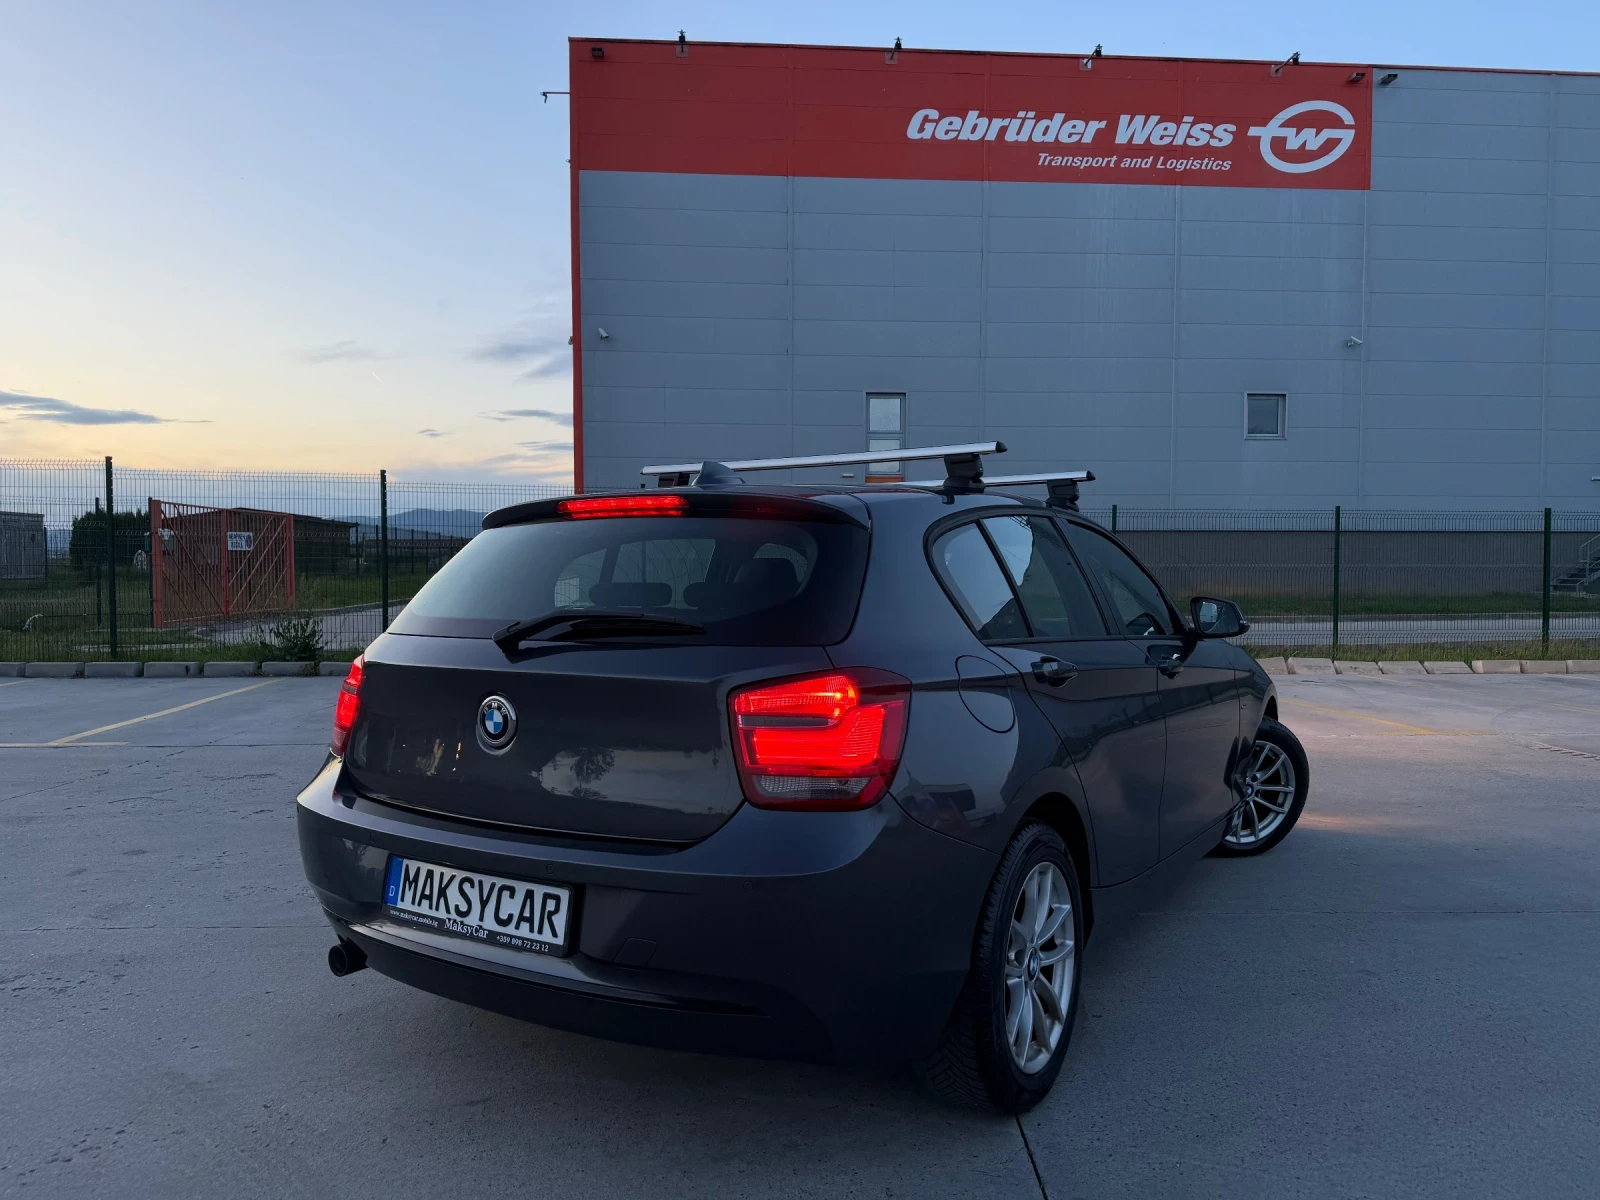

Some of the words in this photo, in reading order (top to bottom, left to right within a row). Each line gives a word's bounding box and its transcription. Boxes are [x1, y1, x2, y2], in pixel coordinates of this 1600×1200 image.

[907, 109, 1107, 143] Gebrüder
[1115, 115, 1236, 146] Weiss
[1038, 154, 1117, 168] Transport
[1121, 156, 1153, 167] and
[1157, 157, 1231, 171] Logistics
[389, 885, 396, 897] D
[400, 863, 561, 938] MAKSYCAR
[444, 919, 489, 938] MaksyCar
[496, 935, 511, 944] +359
